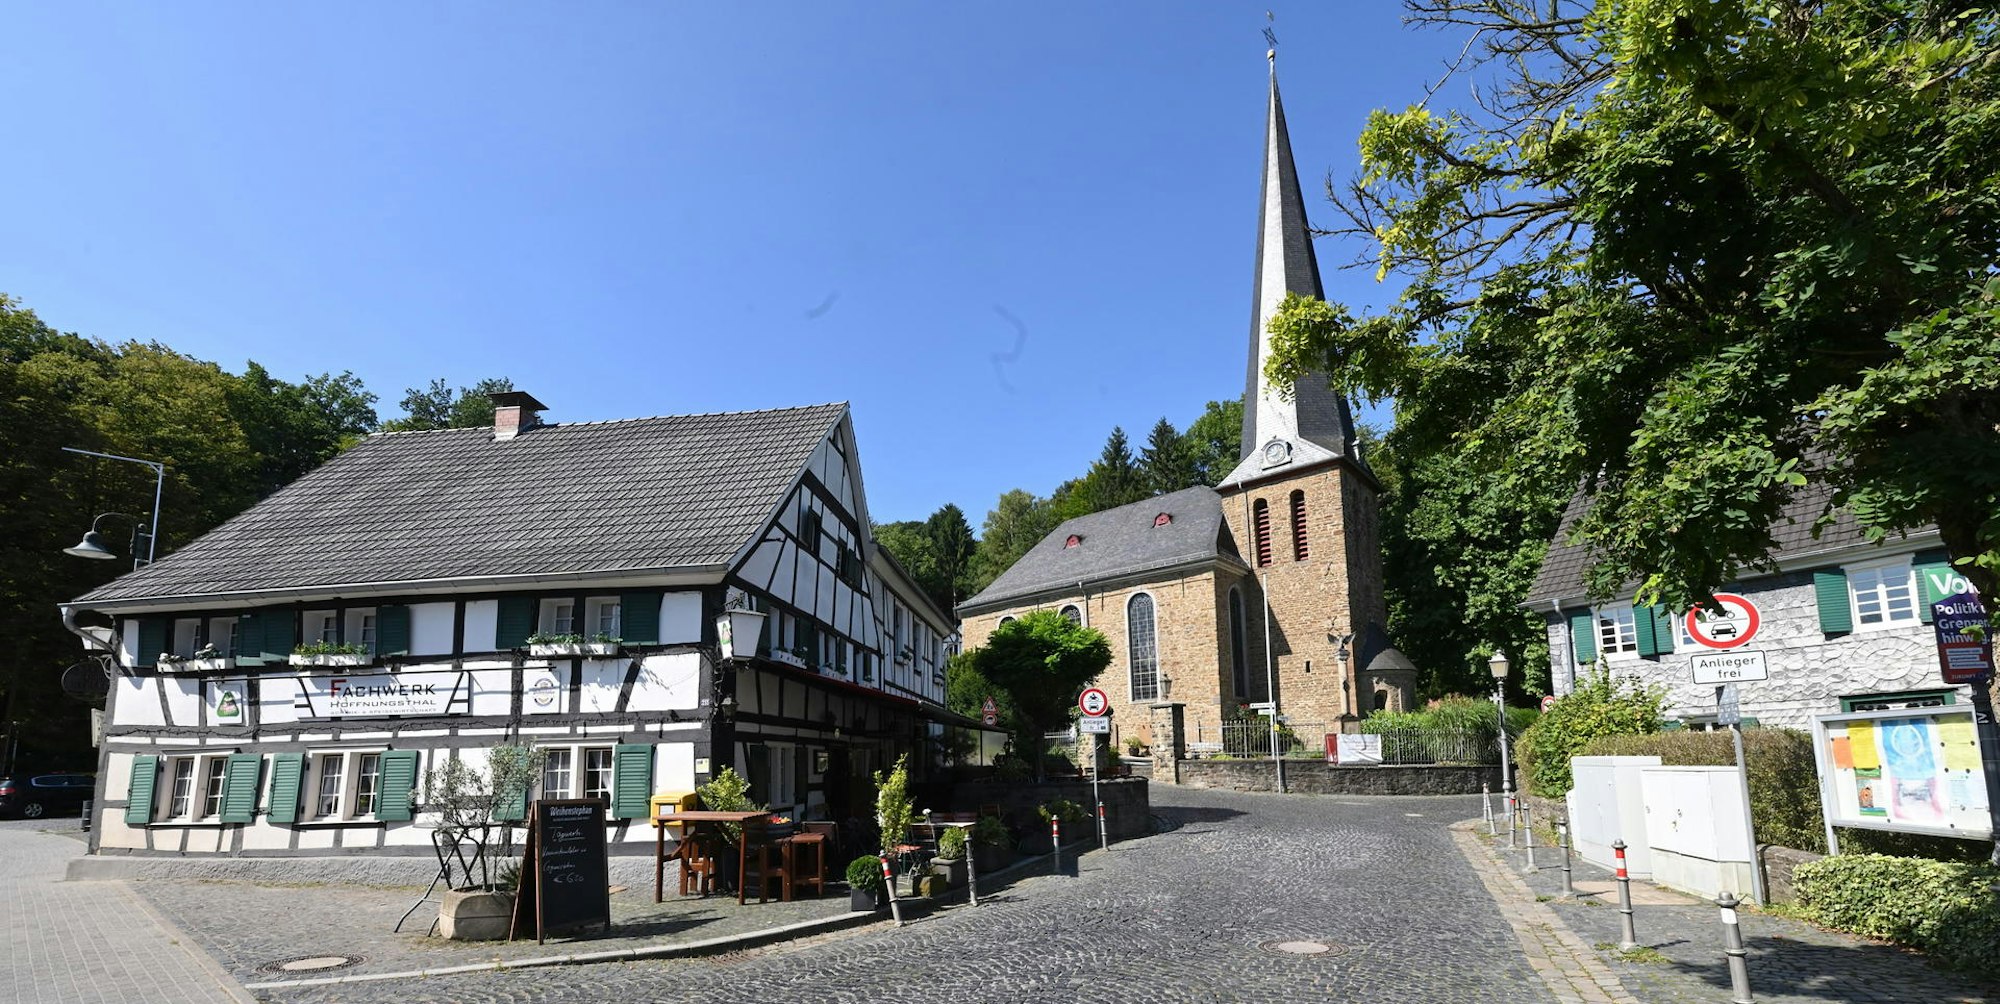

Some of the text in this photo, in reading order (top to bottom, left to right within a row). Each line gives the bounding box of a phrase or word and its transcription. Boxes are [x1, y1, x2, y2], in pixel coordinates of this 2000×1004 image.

[1935, 602, 1979, 615] Politik
[1941, 633, 1991, 645] hinwg.
[1699, 657, 1757, 669] Anlieger
[1718, 669, 1742, 679] frei
[331, 679, 436, 698] FACHWERK
[331, 700, 436, 708] HOFFNUNGSTHAL
[550, 806, 593, 817] Weihenstephan
